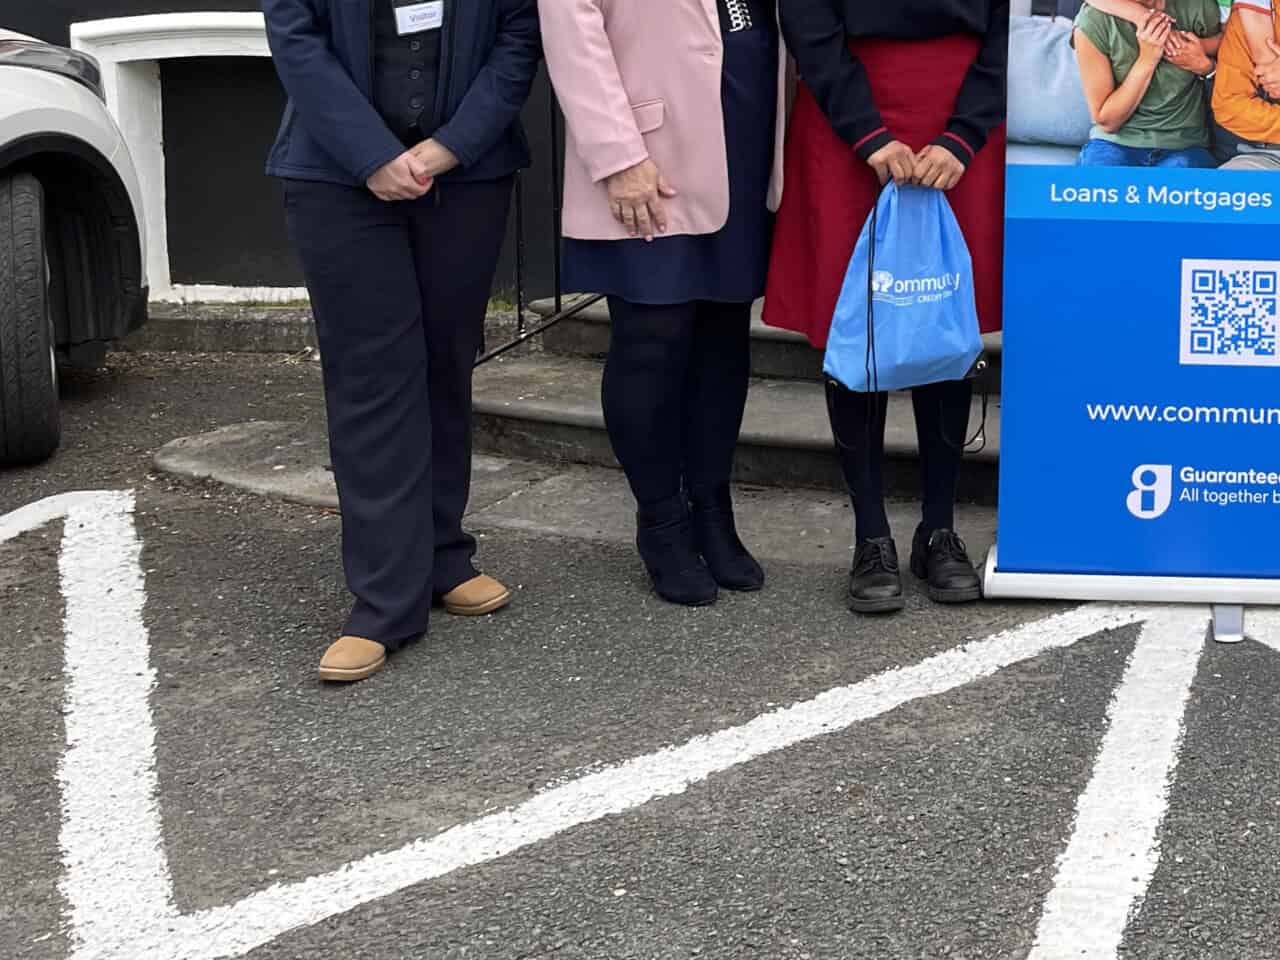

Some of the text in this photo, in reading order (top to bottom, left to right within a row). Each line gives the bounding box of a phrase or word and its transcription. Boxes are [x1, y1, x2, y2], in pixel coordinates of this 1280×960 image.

[1050, 183, 1273, 211] Loans & Mortgages
[1180, 488, 1200, 502] All
[1202, 489, 1268, 506] together
